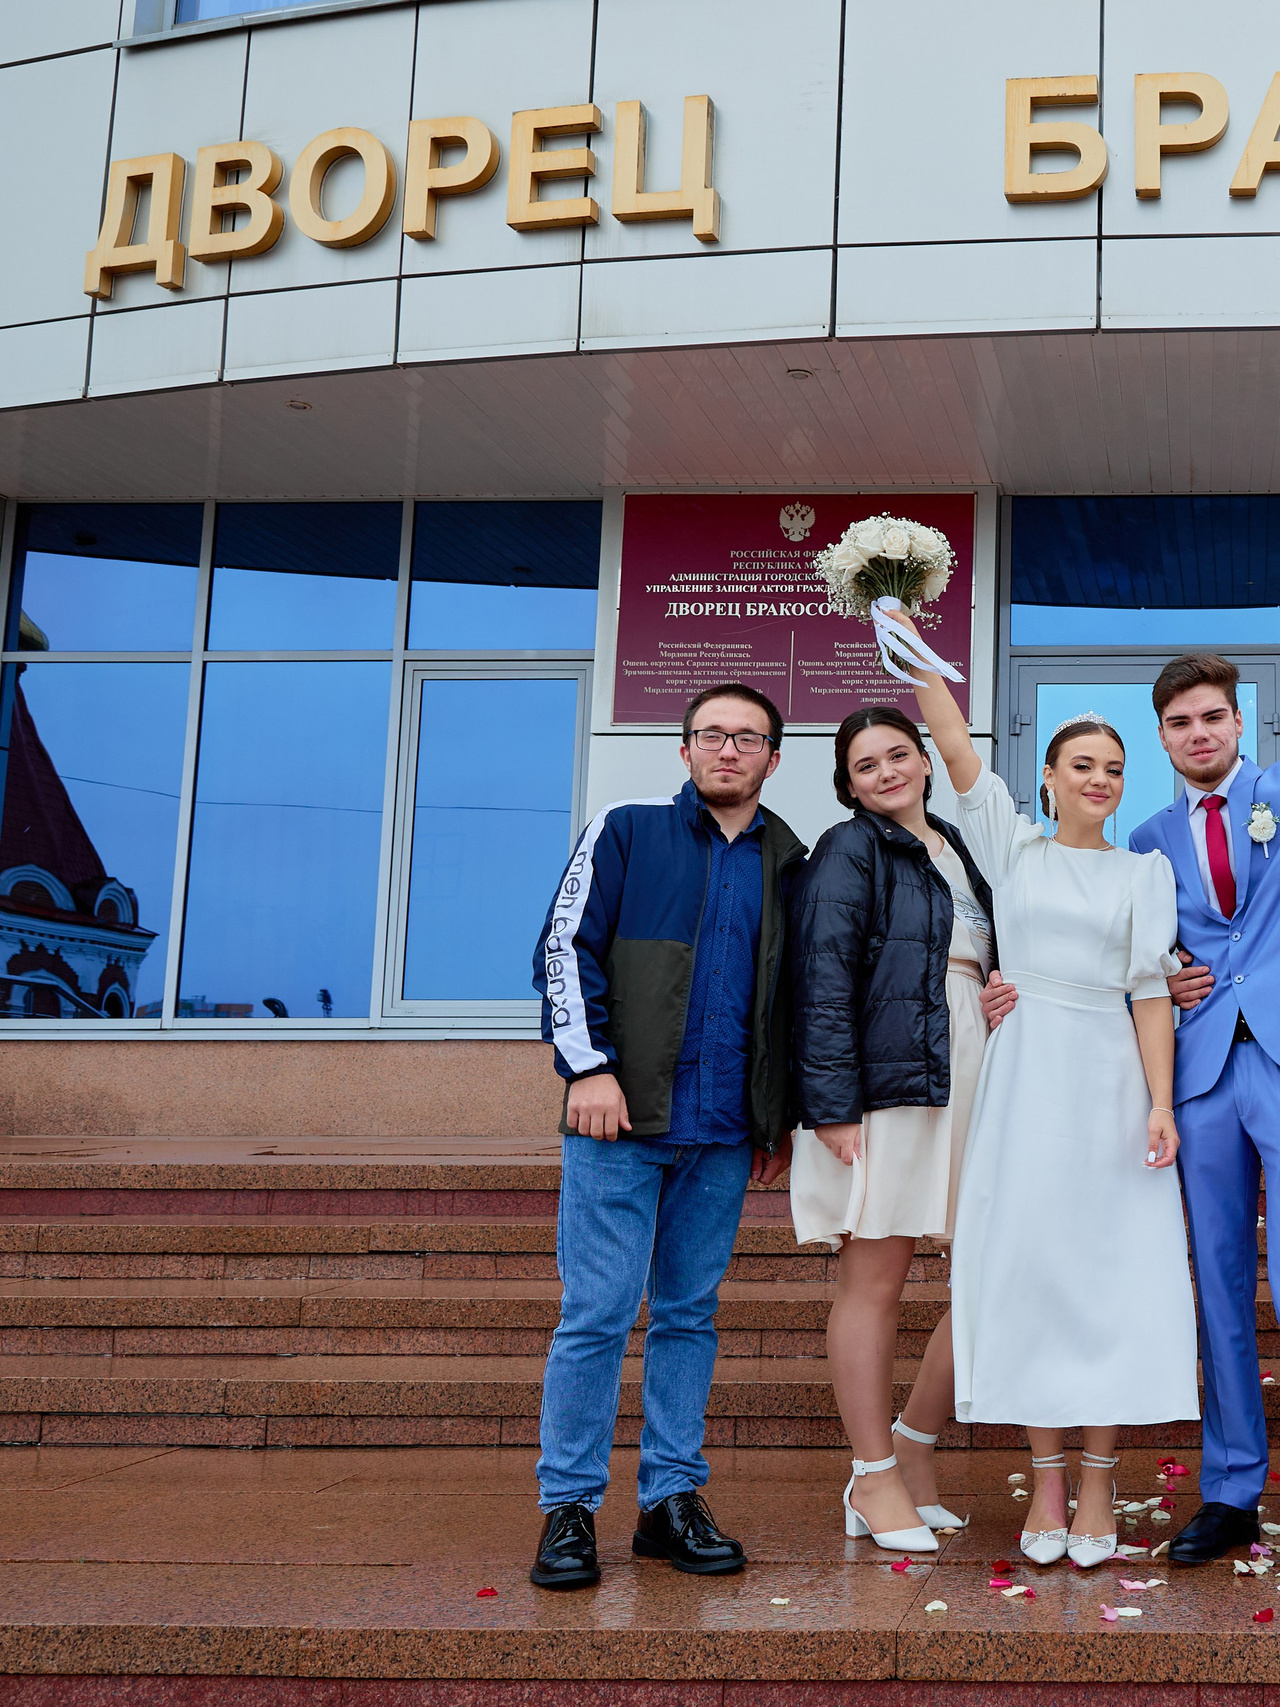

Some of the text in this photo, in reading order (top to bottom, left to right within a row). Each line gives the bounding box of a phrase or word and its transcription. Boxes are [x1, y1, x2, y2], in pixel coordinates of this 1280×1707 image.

[84, 94, 720, 299] ДВОРЕЦ
[731, 549, 800, 558] РОССИЙСКАЯ
[669, 573, 762, 582] АДМИНИСТРАЦИЯ
[665, 603, 740, 618] ДВОРЕЦ
[835, 651, 873, 659] Мордовия
[556, 850, 587, 909] men
